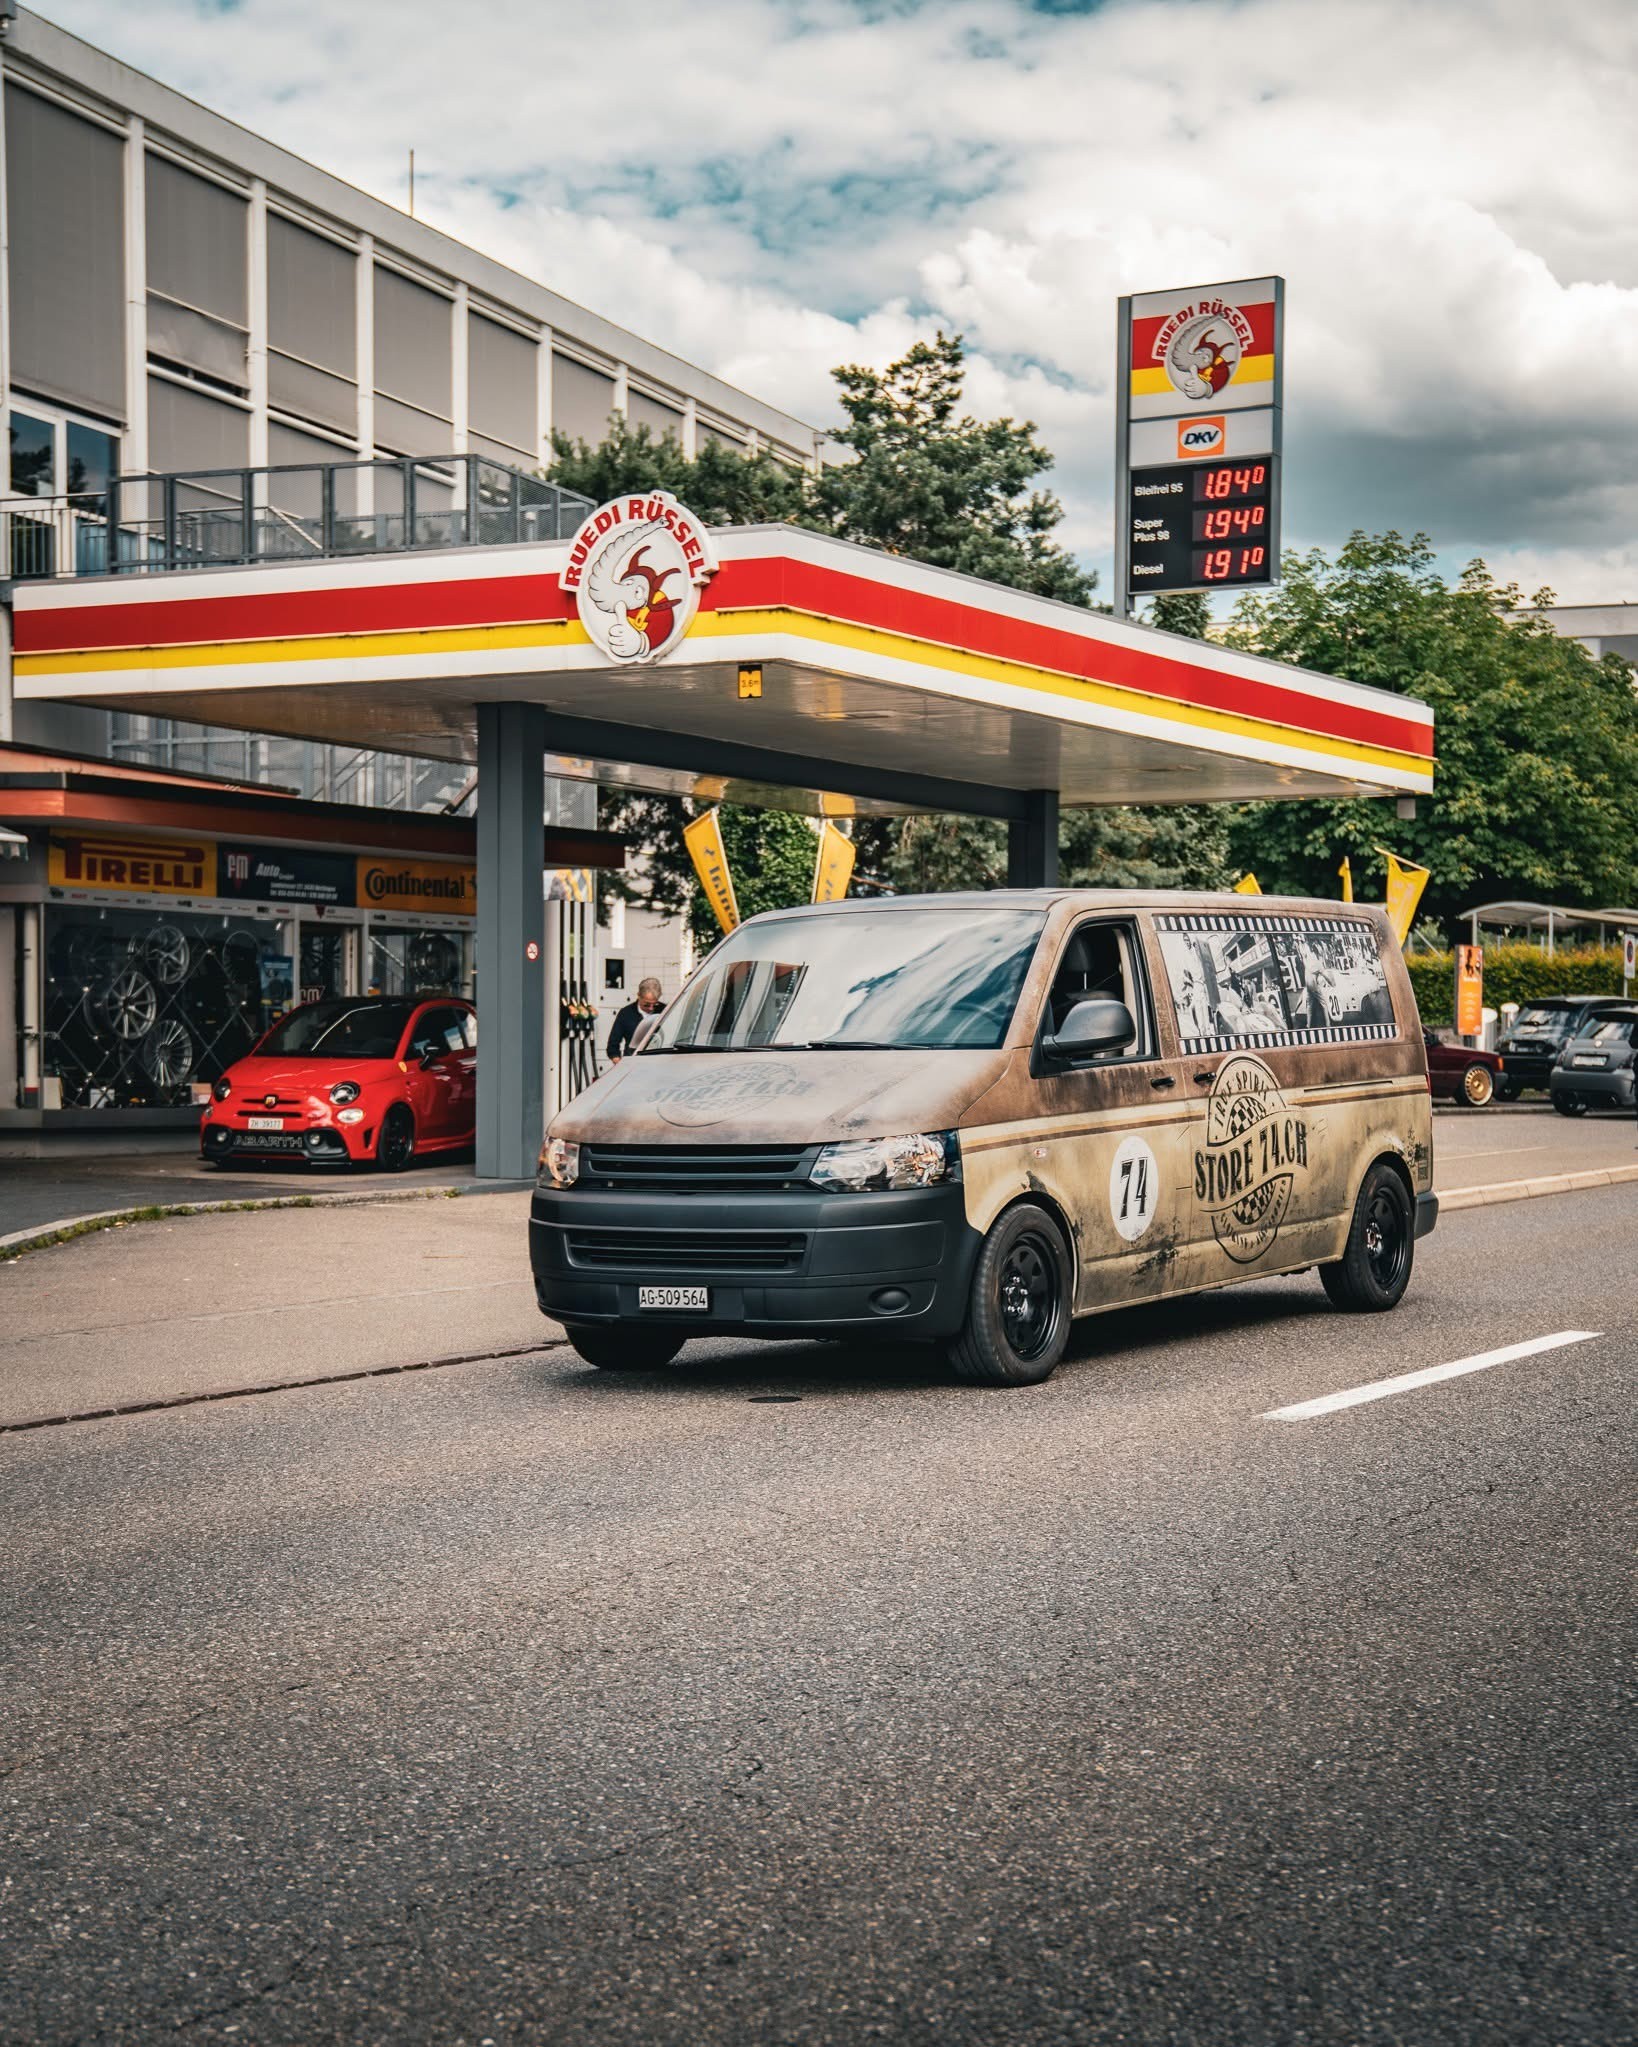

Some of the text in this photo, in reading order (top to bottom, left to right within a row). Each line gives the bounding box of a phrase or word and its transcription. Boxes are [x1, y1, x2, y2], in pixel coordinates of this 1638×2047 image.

[1156, 298, 1251, 357] RUEDI RÜSSEL
[1184, 430, 1220, 446] DKV
[1134, 482, 1184, 496] Bleifrei 95
[1133, 519, 1164, 530] Super
[564, 494, 705, 587] RUEDI RÜSSEL
[1133, 532, 1156, 542] Plus
[1133, 564, 1164, 575] Diesel
[65, 837, 205, 889] PIRELLI
[255, 863, 281, 877] Auto
[365, 868, 465, 900] Continental
[233, 1135, 303, 1148] ABARTH
[1194, 1138, 1254, 1203] STORE
[1120, 1156, 1150, 1221] 74
